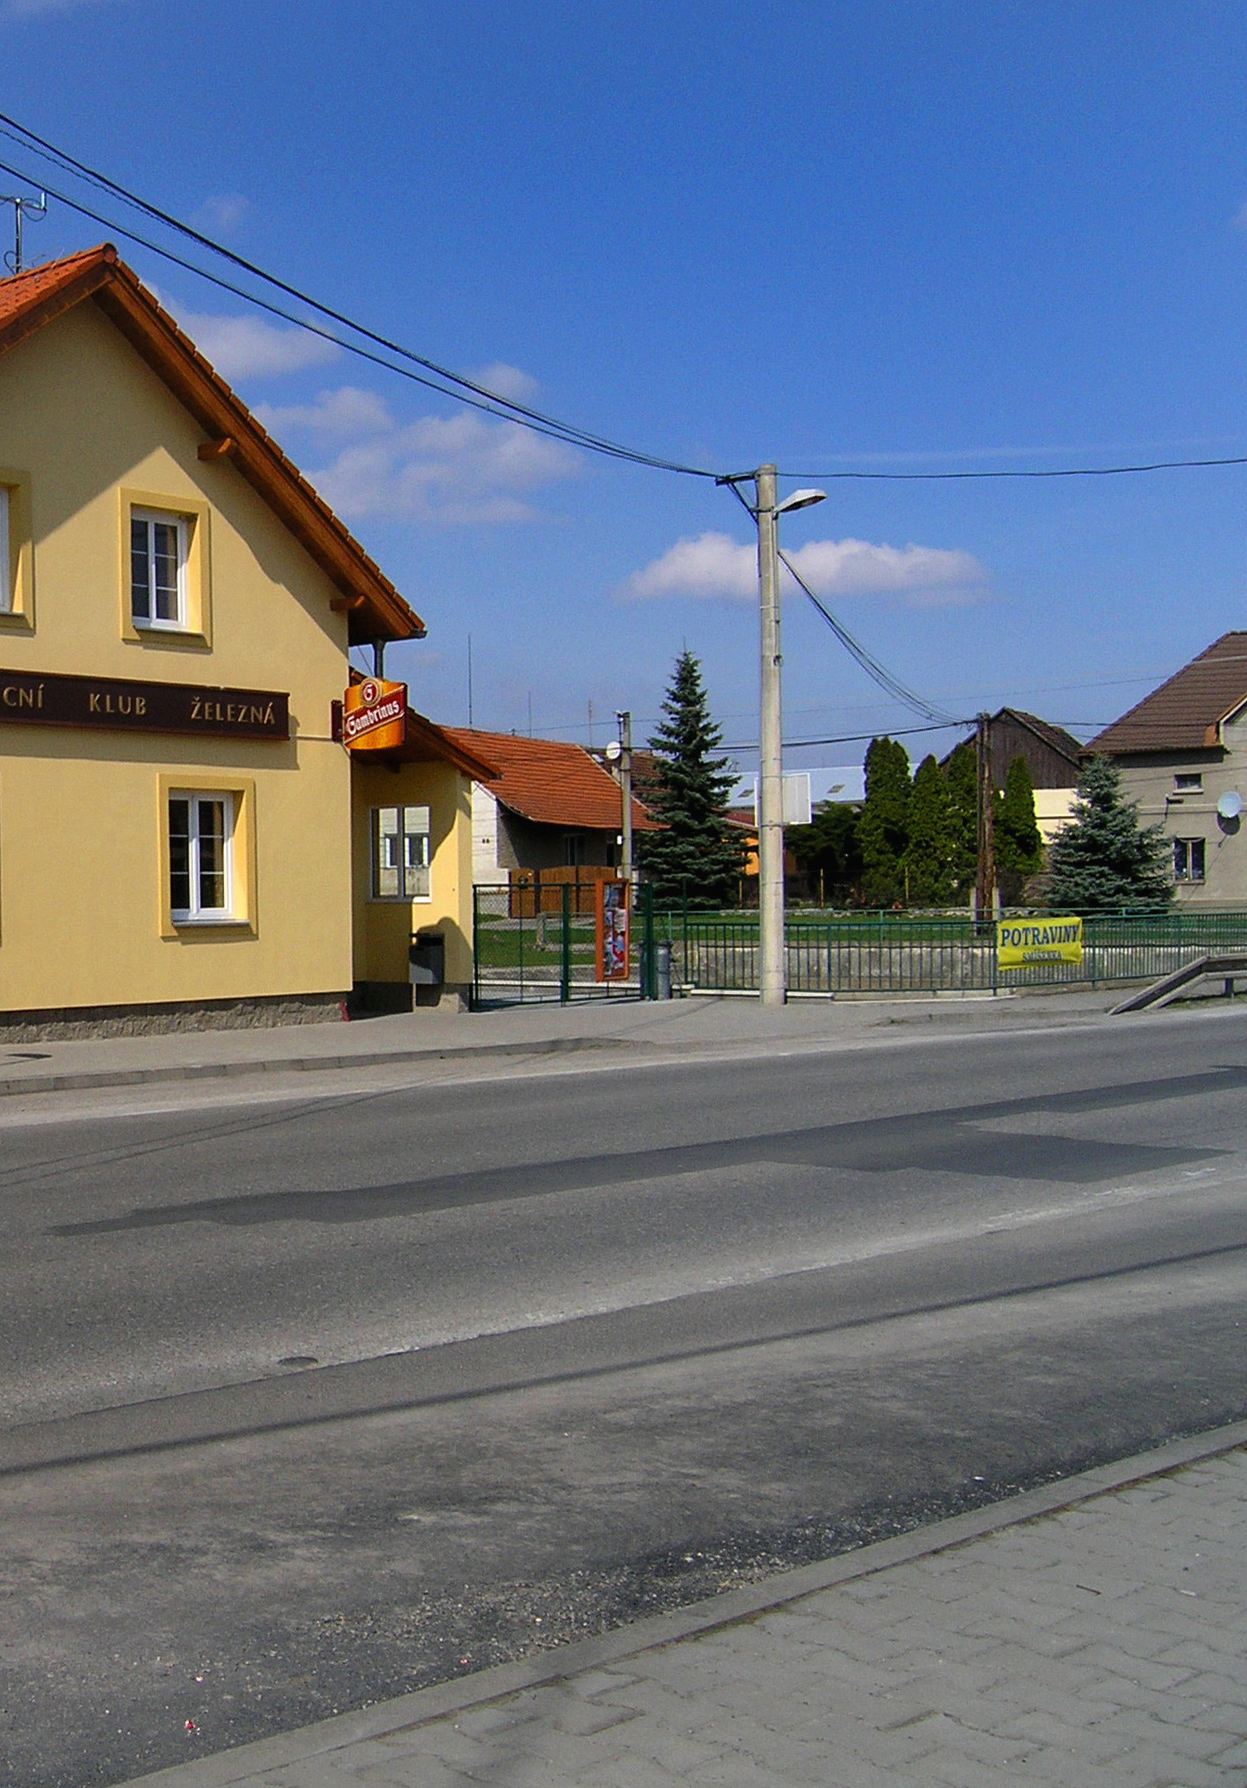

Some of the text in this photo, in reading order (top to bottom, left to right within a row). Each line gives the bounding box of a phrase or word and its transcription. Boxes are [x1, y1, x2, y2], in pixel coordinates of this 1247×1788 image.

[89, 693, 147, 715] KLUB
[190, 696, 276, 725] ŽELEZNÁ
[346, 700, 400, 736] Gambrinus
[1000, 924, 1079, 947] POTRAVINY
